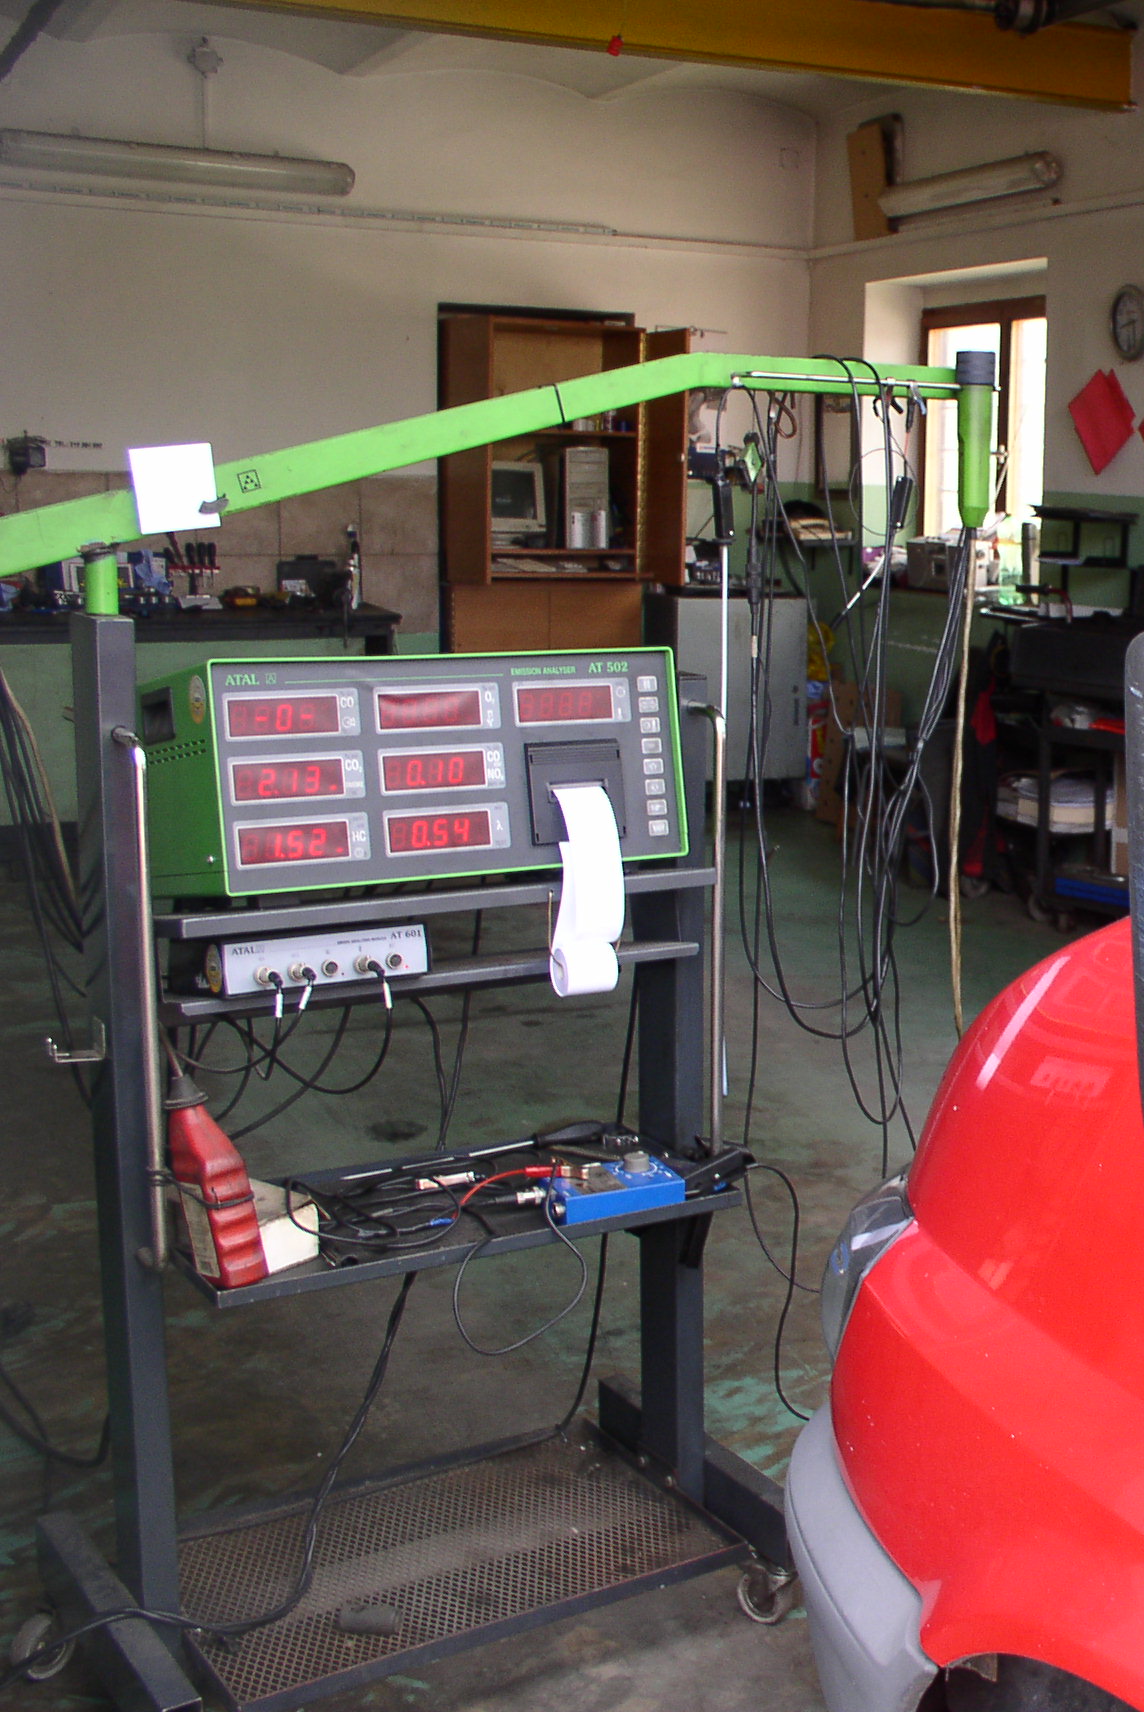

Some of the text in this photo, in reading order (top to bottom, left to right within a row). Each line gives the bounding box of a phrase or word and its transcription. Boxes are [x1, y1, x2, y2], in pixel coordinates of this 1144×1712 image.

[588, 661, 629, 673] AT 502
[225, 674, 260, 686] ATAL
[340, 696, 354, 708] CO
[351, 830, 367, 843] HC
[411, 817, 470, 849] 0.54
[390, 928, 422, 940] AT 601
